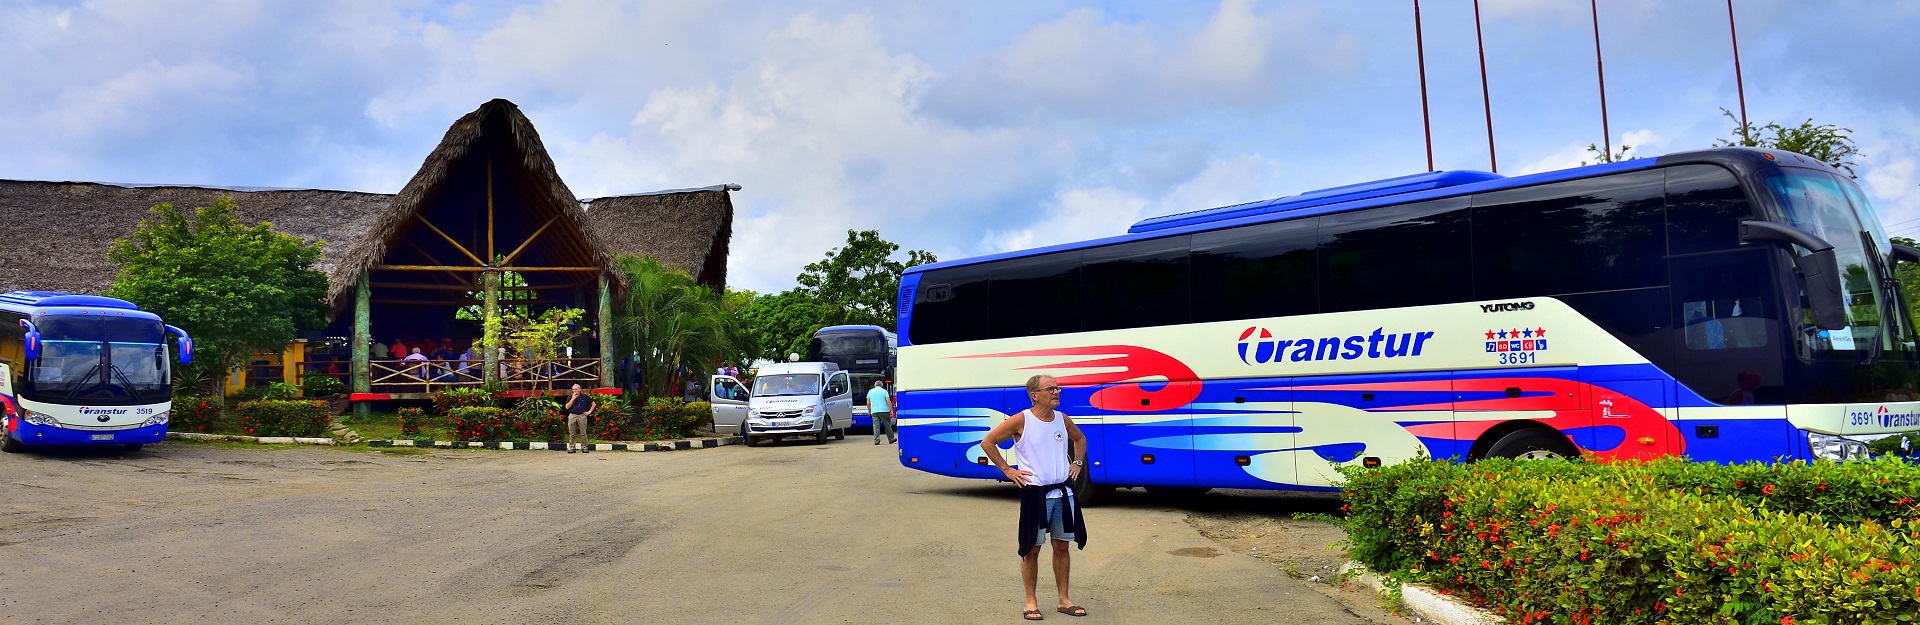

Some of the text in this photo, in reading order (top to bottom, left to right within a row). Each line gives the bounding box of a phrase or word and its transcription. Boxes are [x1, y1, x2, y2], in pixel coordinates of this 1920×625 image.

[1480, 301, 1535, 313] YUTONG
[1499, 352, 1535, 364] 3691
[1851, 412, 1874, 426] 3691
